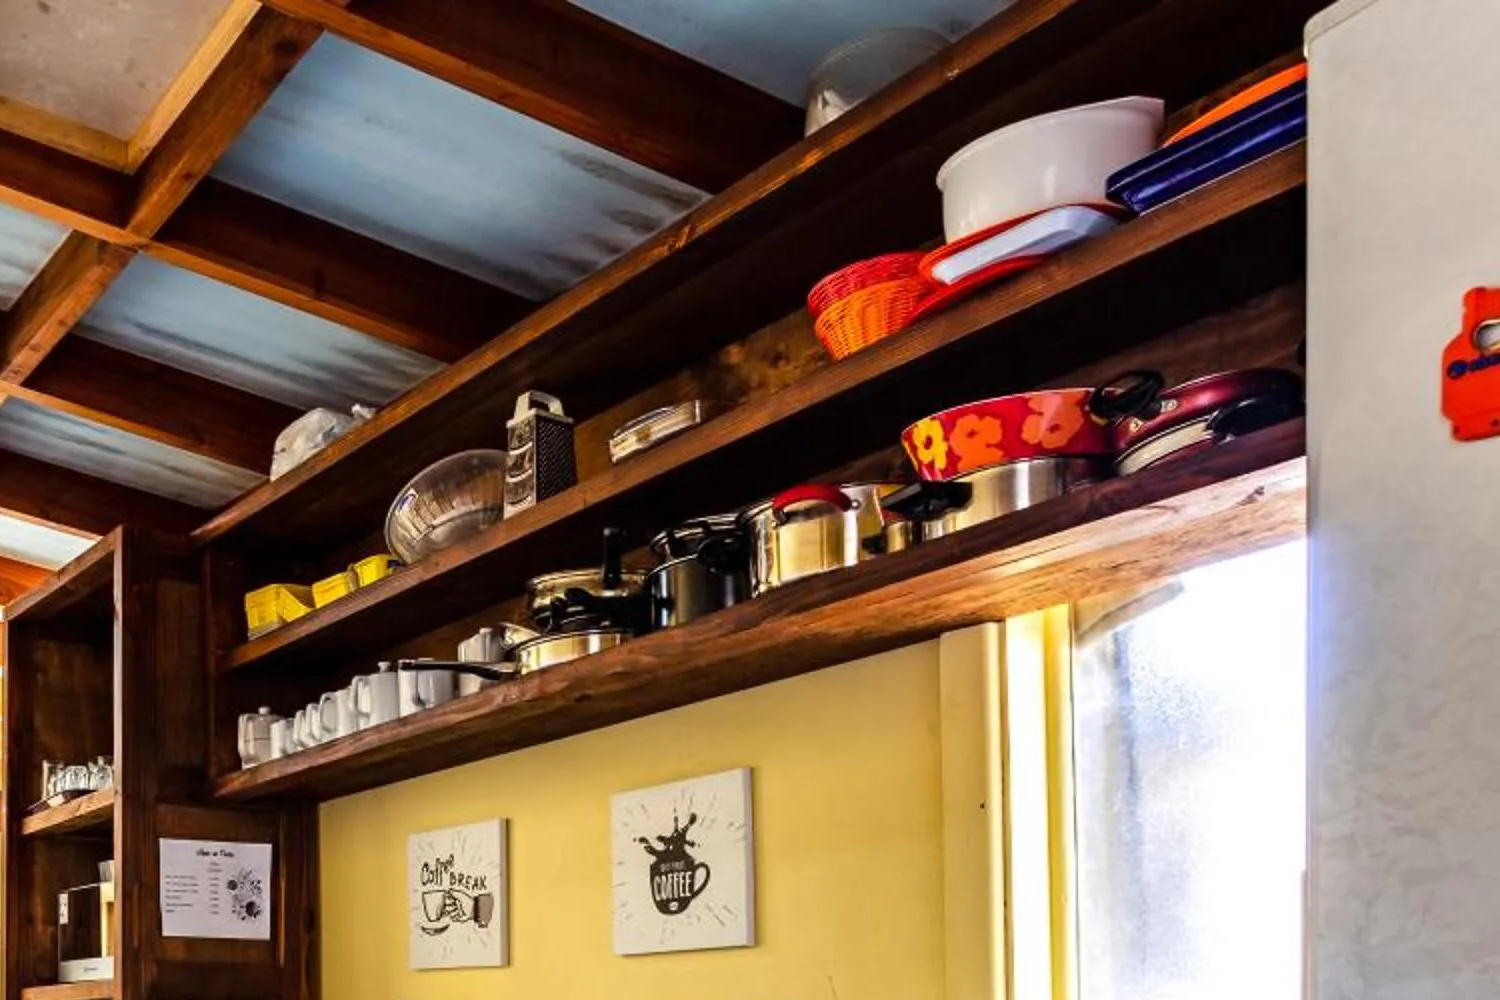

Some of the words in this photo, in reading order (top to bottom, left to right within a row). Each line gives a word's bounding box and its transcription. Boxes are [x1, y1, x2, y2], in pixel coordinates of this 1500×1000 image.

[420, 853, 455, 886] Coffee
[449, 871, 488, 891] BREAK
[653, 871, 693, 901] COFFEE
